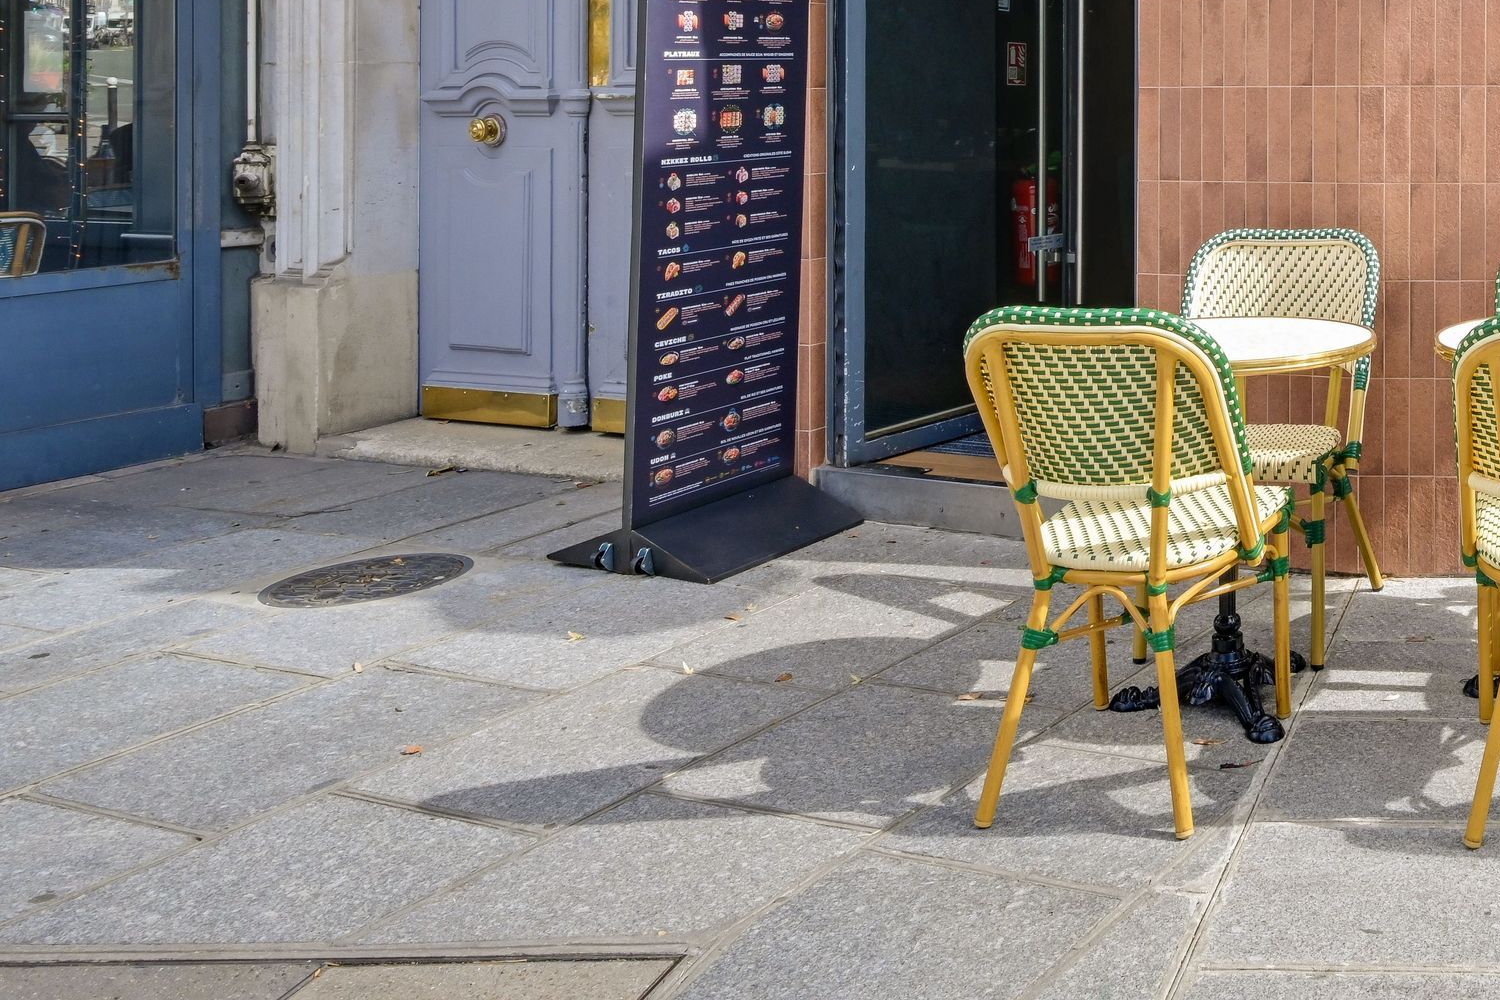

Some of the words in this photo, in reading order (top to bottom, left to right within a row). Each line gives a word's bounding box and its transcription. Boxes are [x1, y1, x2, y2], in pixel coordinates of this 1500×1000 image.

[661, 158, 689, 166] NIKKEI
[690, 155, 712, 164] ROLLS
[658, 247, 681, 256] TACOS
[656, 288, 693, 300] TIRADITO
[654, 336, 687, 348] CEVICHE
[654, 373, 672, 382] POKE
[652, 410, 684, 424] DONBURI
[650, 455, 669, 465] UDON
